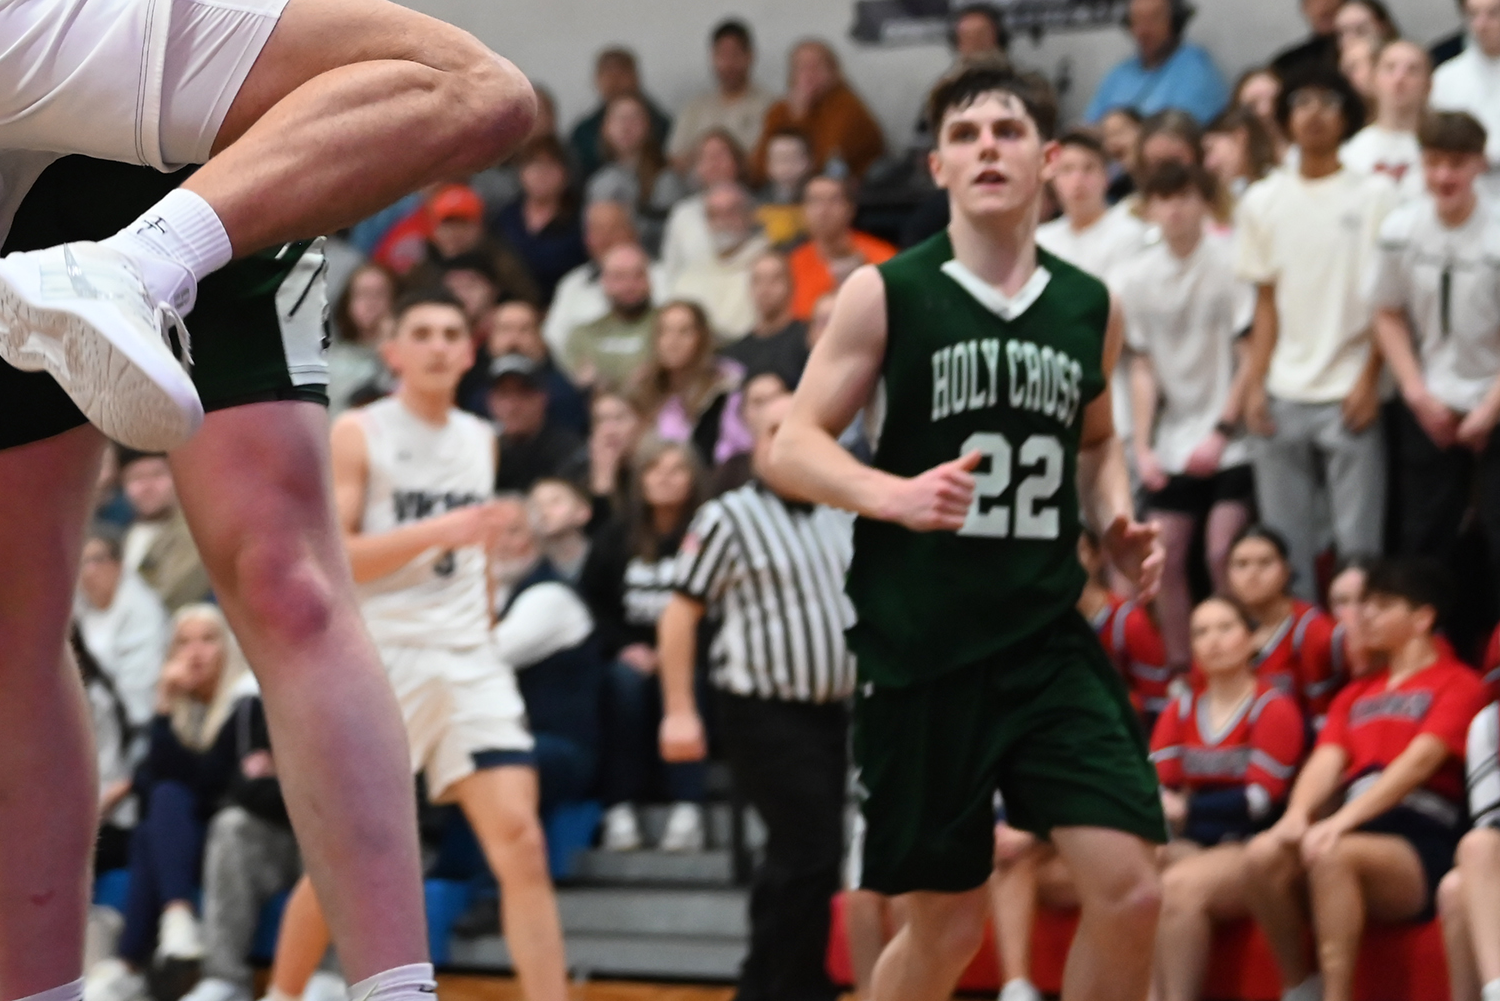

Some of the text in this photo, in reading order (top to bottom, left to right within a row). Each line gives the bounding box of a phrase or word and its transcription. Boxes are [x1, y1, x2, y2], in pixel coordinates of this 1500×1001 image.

[930, 336, 1084, 428] HOLY CROSS
[956, 431, 1065, 540] 22
